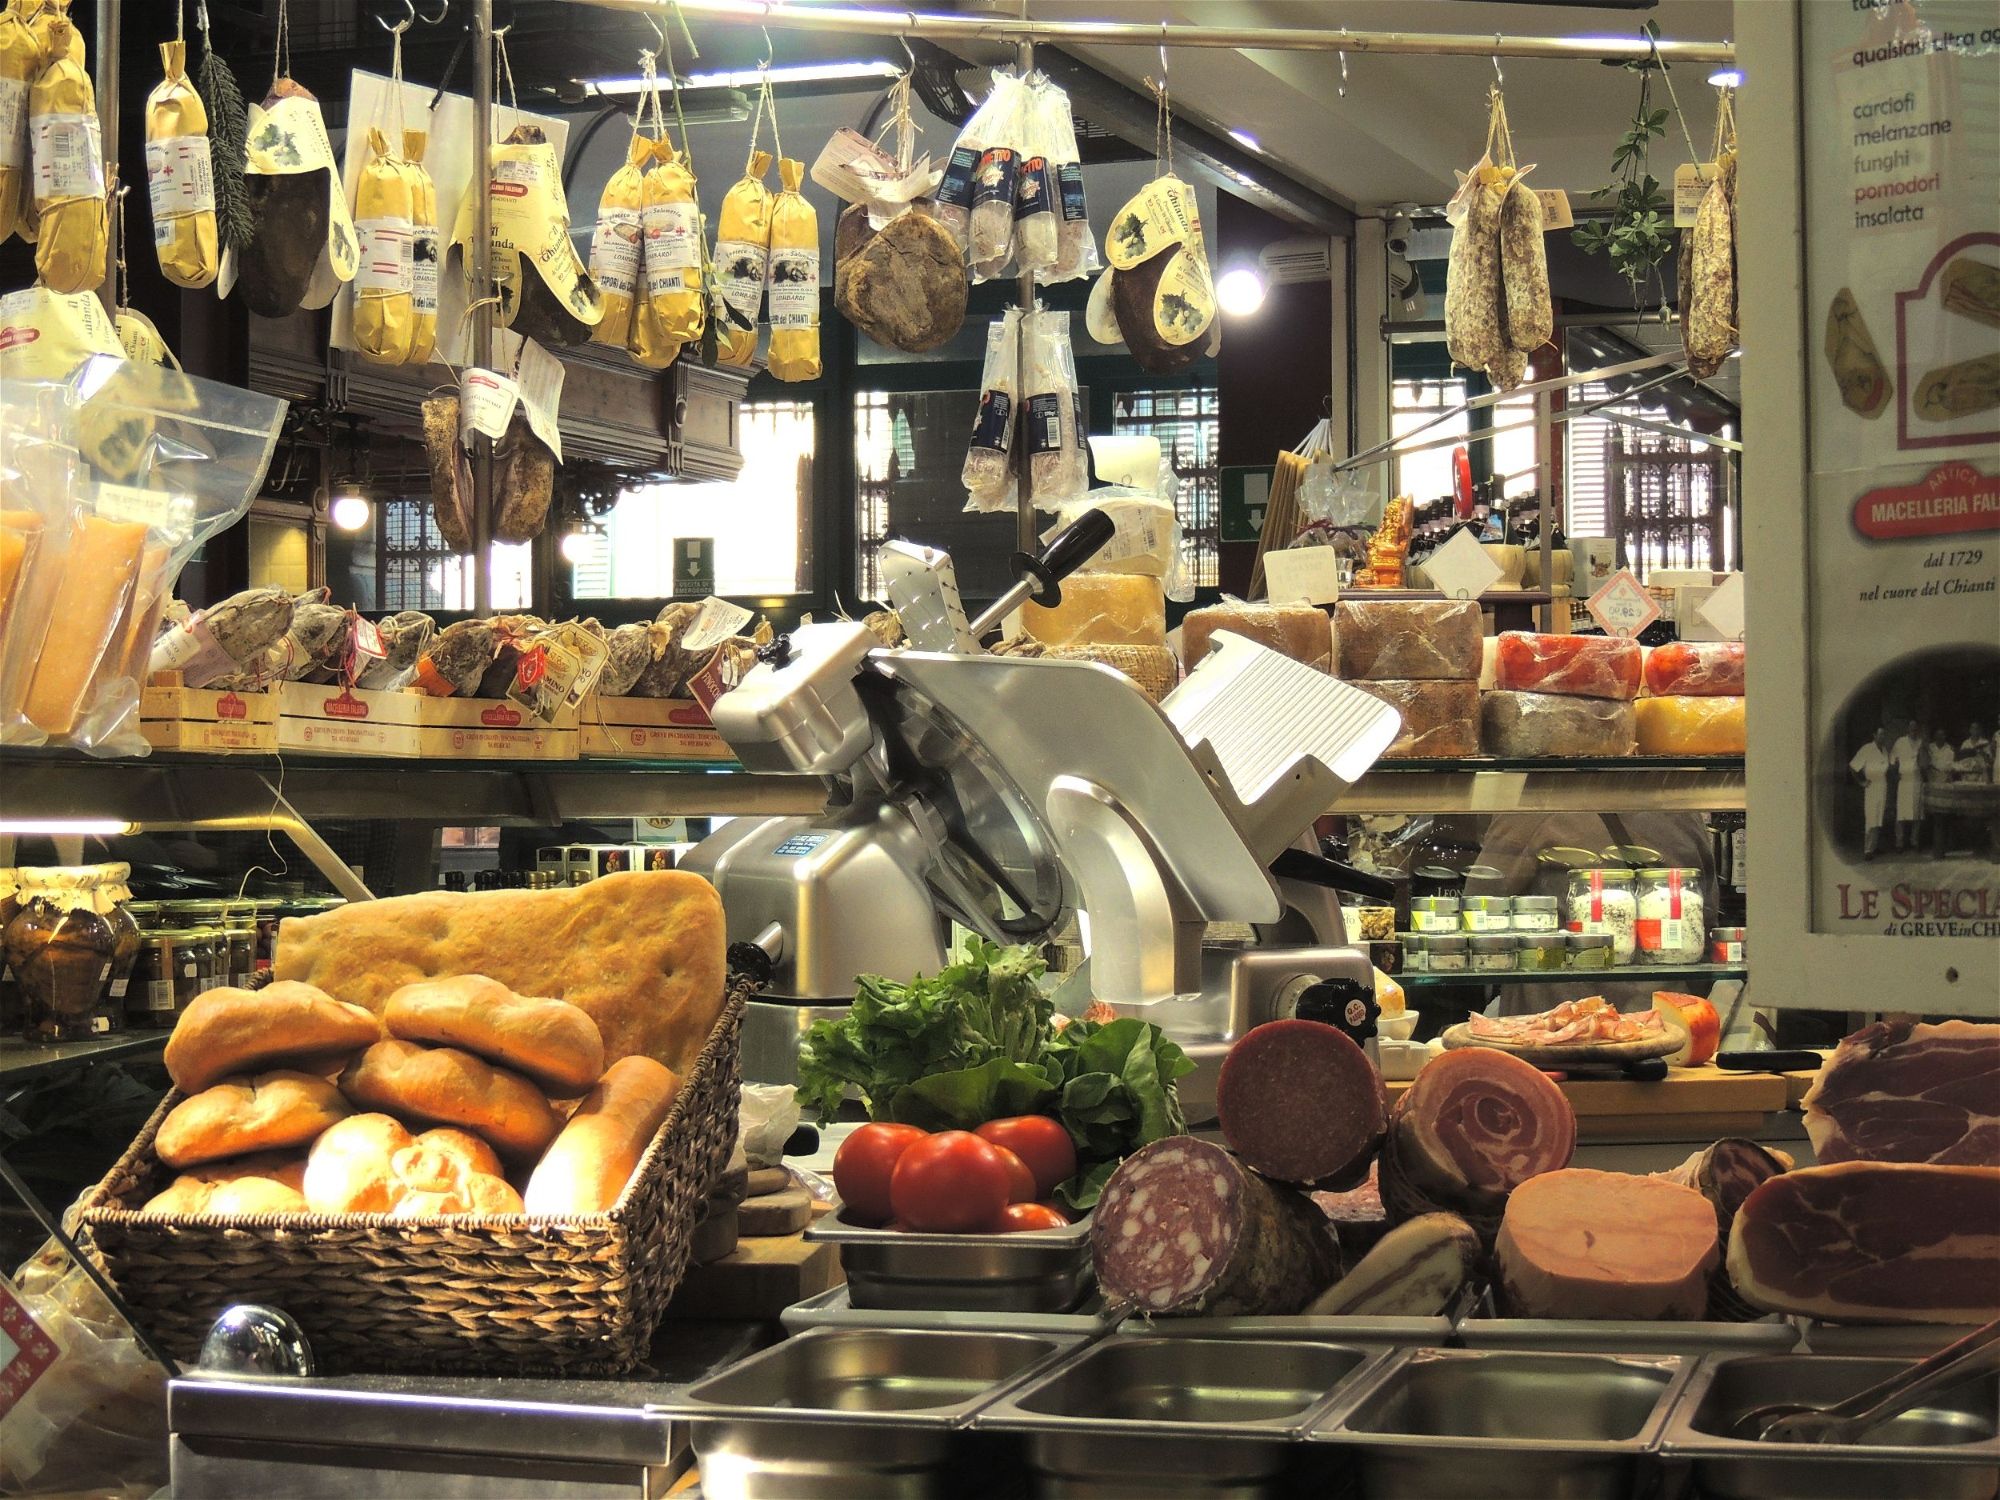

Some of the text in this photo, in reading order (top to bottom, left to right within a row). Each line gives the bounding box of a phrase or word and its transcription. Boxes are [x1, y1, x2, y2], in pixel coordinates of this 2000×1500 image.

[1853, 92, 1915, 119] carciofi
[1854, 119, 1952, 147] melanzane
[1855, 151, 1909, 174] funghi
[1855, 173, 1941, 204] pomodori
[1855, 205, 1924, 229] insalata
[660, 277, 680, 289] CHIANTI
[789, 313, 809, 324] CHIANTI
[1928, 468, 1979, 492] ANTICA
[1871, 493, 2000, 522] MACELLERIA FAL
[1923, 549, 1983, 568] dal 1729
[1859, 576, 1995, 601] nel cuore del Chianti
[1884, 922, 1897, 936] di
